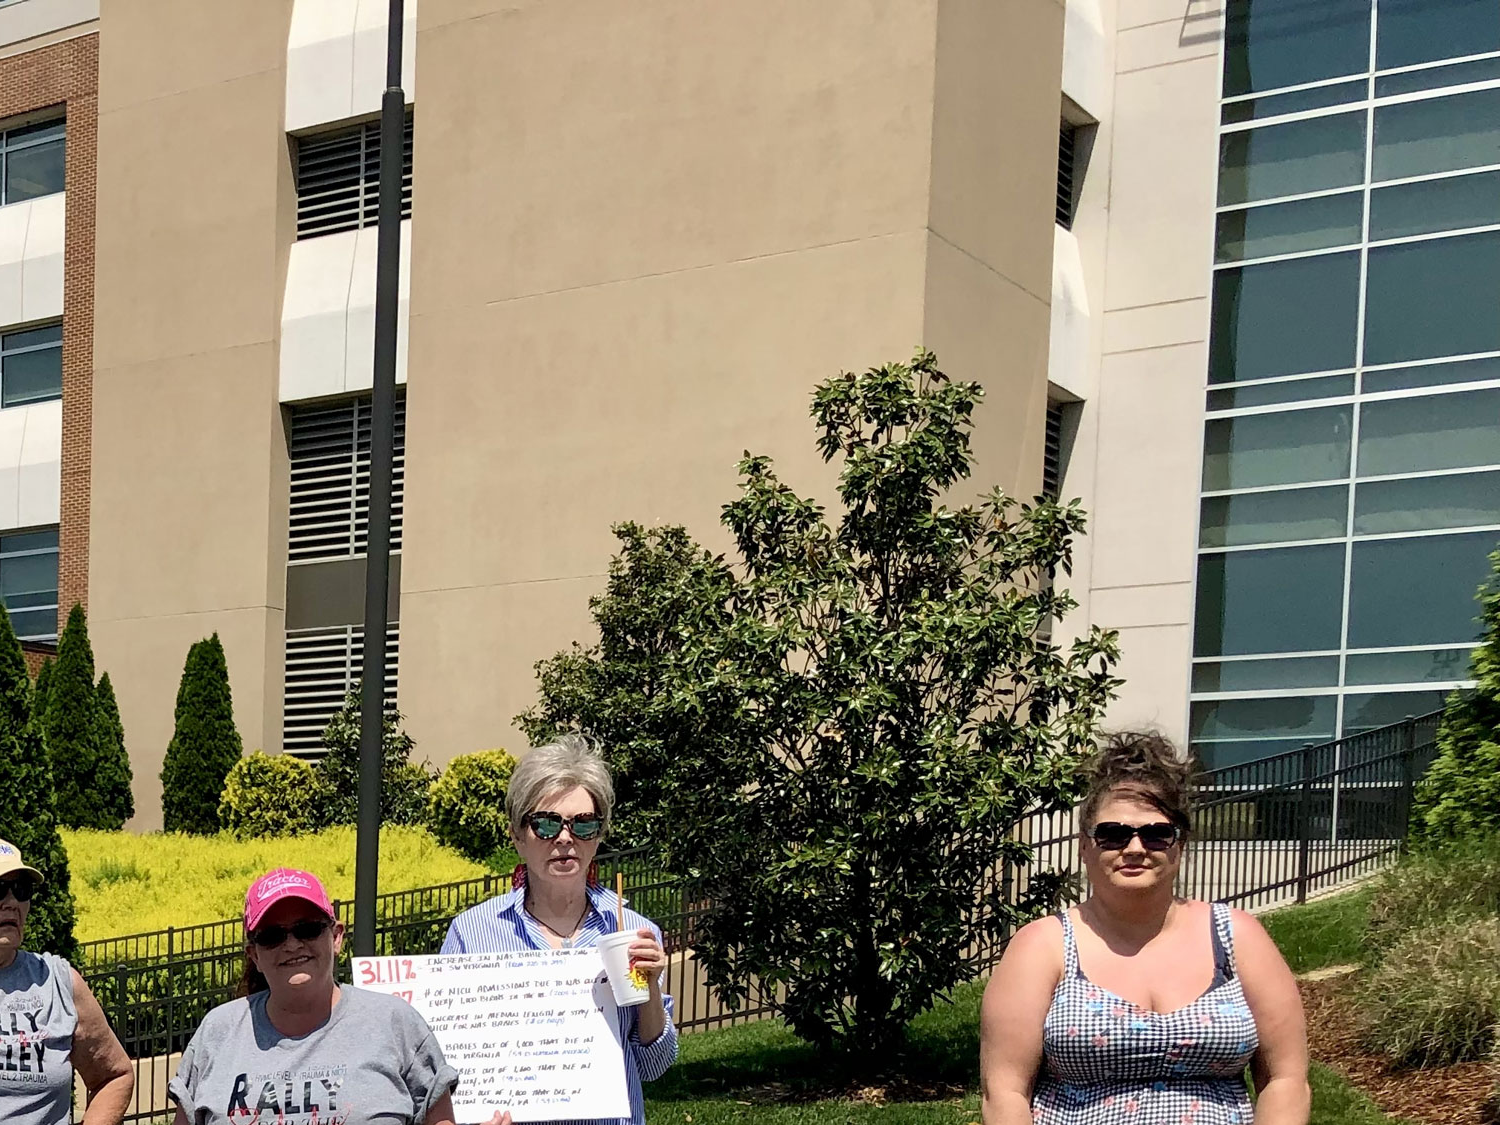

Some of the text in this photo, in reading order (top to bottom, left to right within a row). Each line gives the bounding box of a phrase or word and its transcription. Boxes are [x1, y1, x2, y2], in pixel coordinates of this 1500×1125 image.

[257, 875, 310, 898] Tractor
[19, 1072, 48, 1084] TRAUMA
[227, 1073, 344, 1116] RALLY
